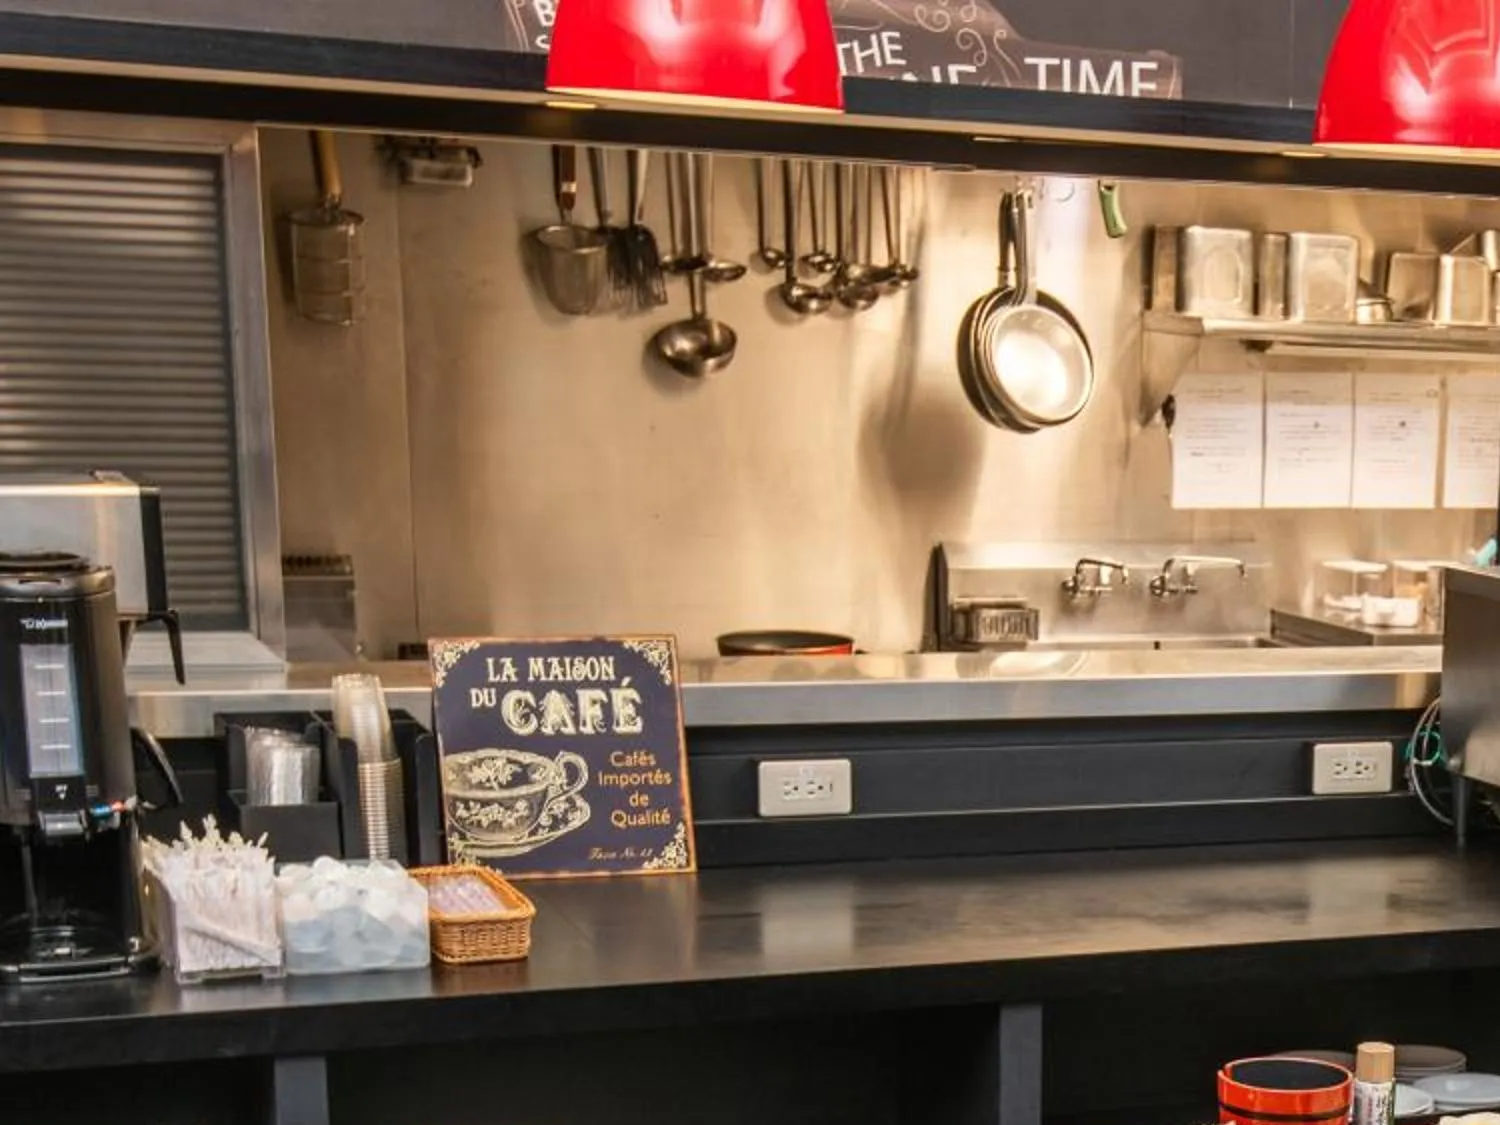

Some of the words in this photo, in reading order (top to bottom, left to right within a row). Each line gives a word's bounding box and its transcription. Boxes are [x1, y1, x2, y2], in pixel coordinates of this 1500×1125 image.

[486, 657, 518, 683] LA
[528, 655, 616, 682] MAISON
[469, 687, 497, 708] DU
[500, 677, 643, 736] CAFÉ
[598, 768, 673, 787] Importés
[629, 789, 649, 807] de
[610, 808, 671, 829] Qualité
